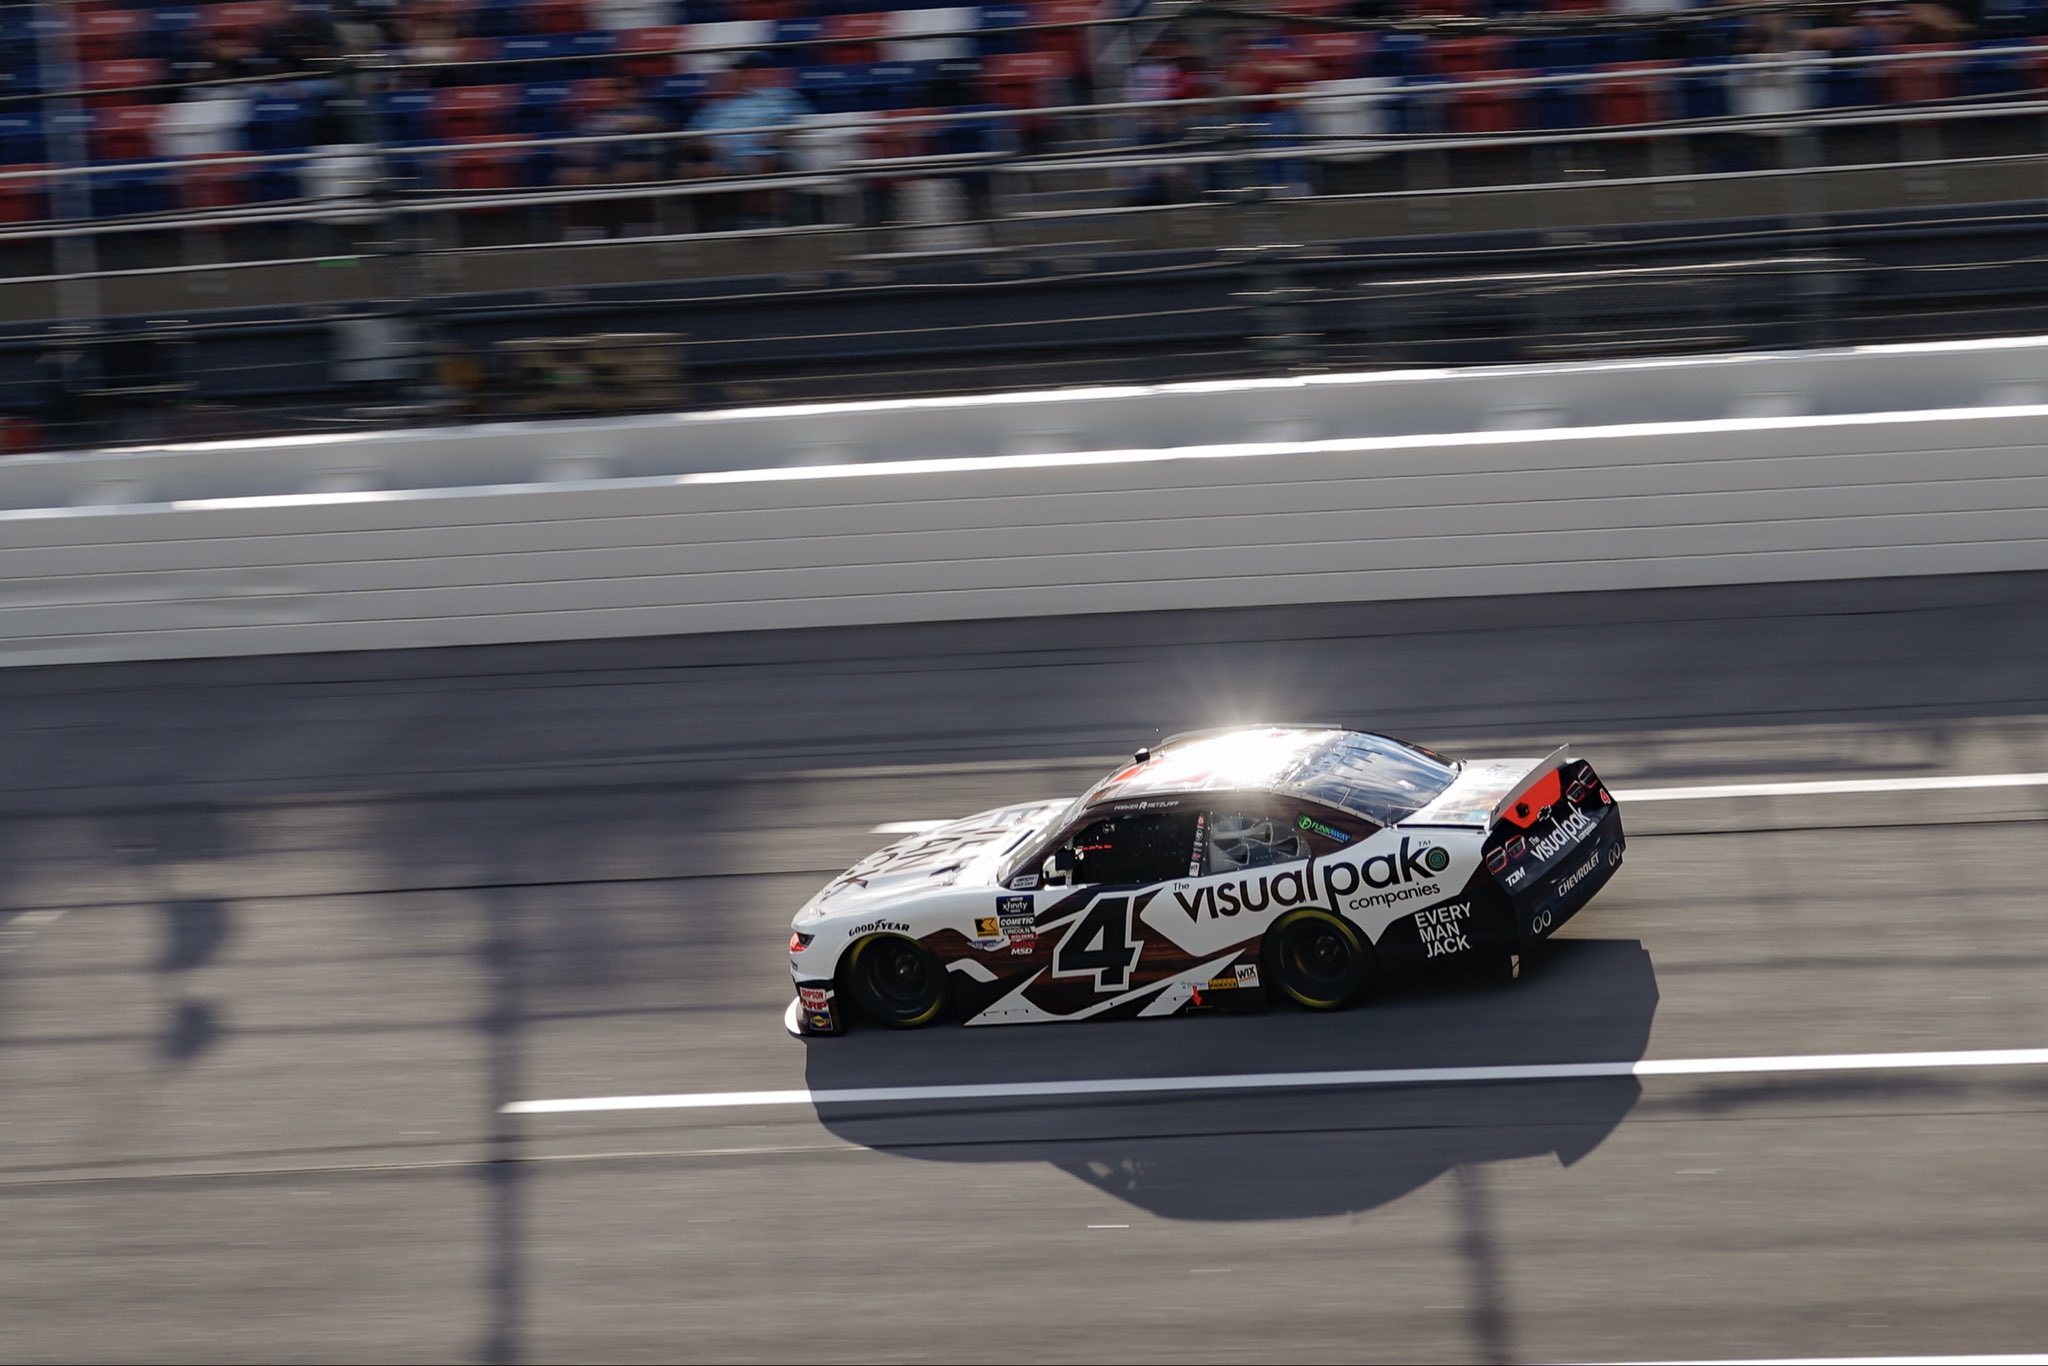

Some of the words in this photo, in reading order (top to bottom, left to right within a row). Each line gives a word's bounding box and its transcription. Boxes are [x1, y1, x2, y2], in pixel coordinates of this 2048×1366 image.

[1311, 822, 1350, 841] FUNKAWAY
[1529, 836, 1540, 846] The
[1558, 851, 1599, 897] CHEVROLET
[1173, 882, 1190, 891] The
[1349, 883, 1441, 911] companies
[1003, 901, 1028, 912] xfinity
[1414, 902, 1471, 928] EVERY
[848, 919, 910, 937] GOODYEAR
[1001, 917, 1034, 926] COMETIC
[1004, 927, 1030, 935] LINCOLN
[1419, 921, 1460, 943] MAN
[1052, 891, 1144, 992] 4
[1427, 934, 1471, 958] JACK
[1237, 966, 1255, 979] WIX
